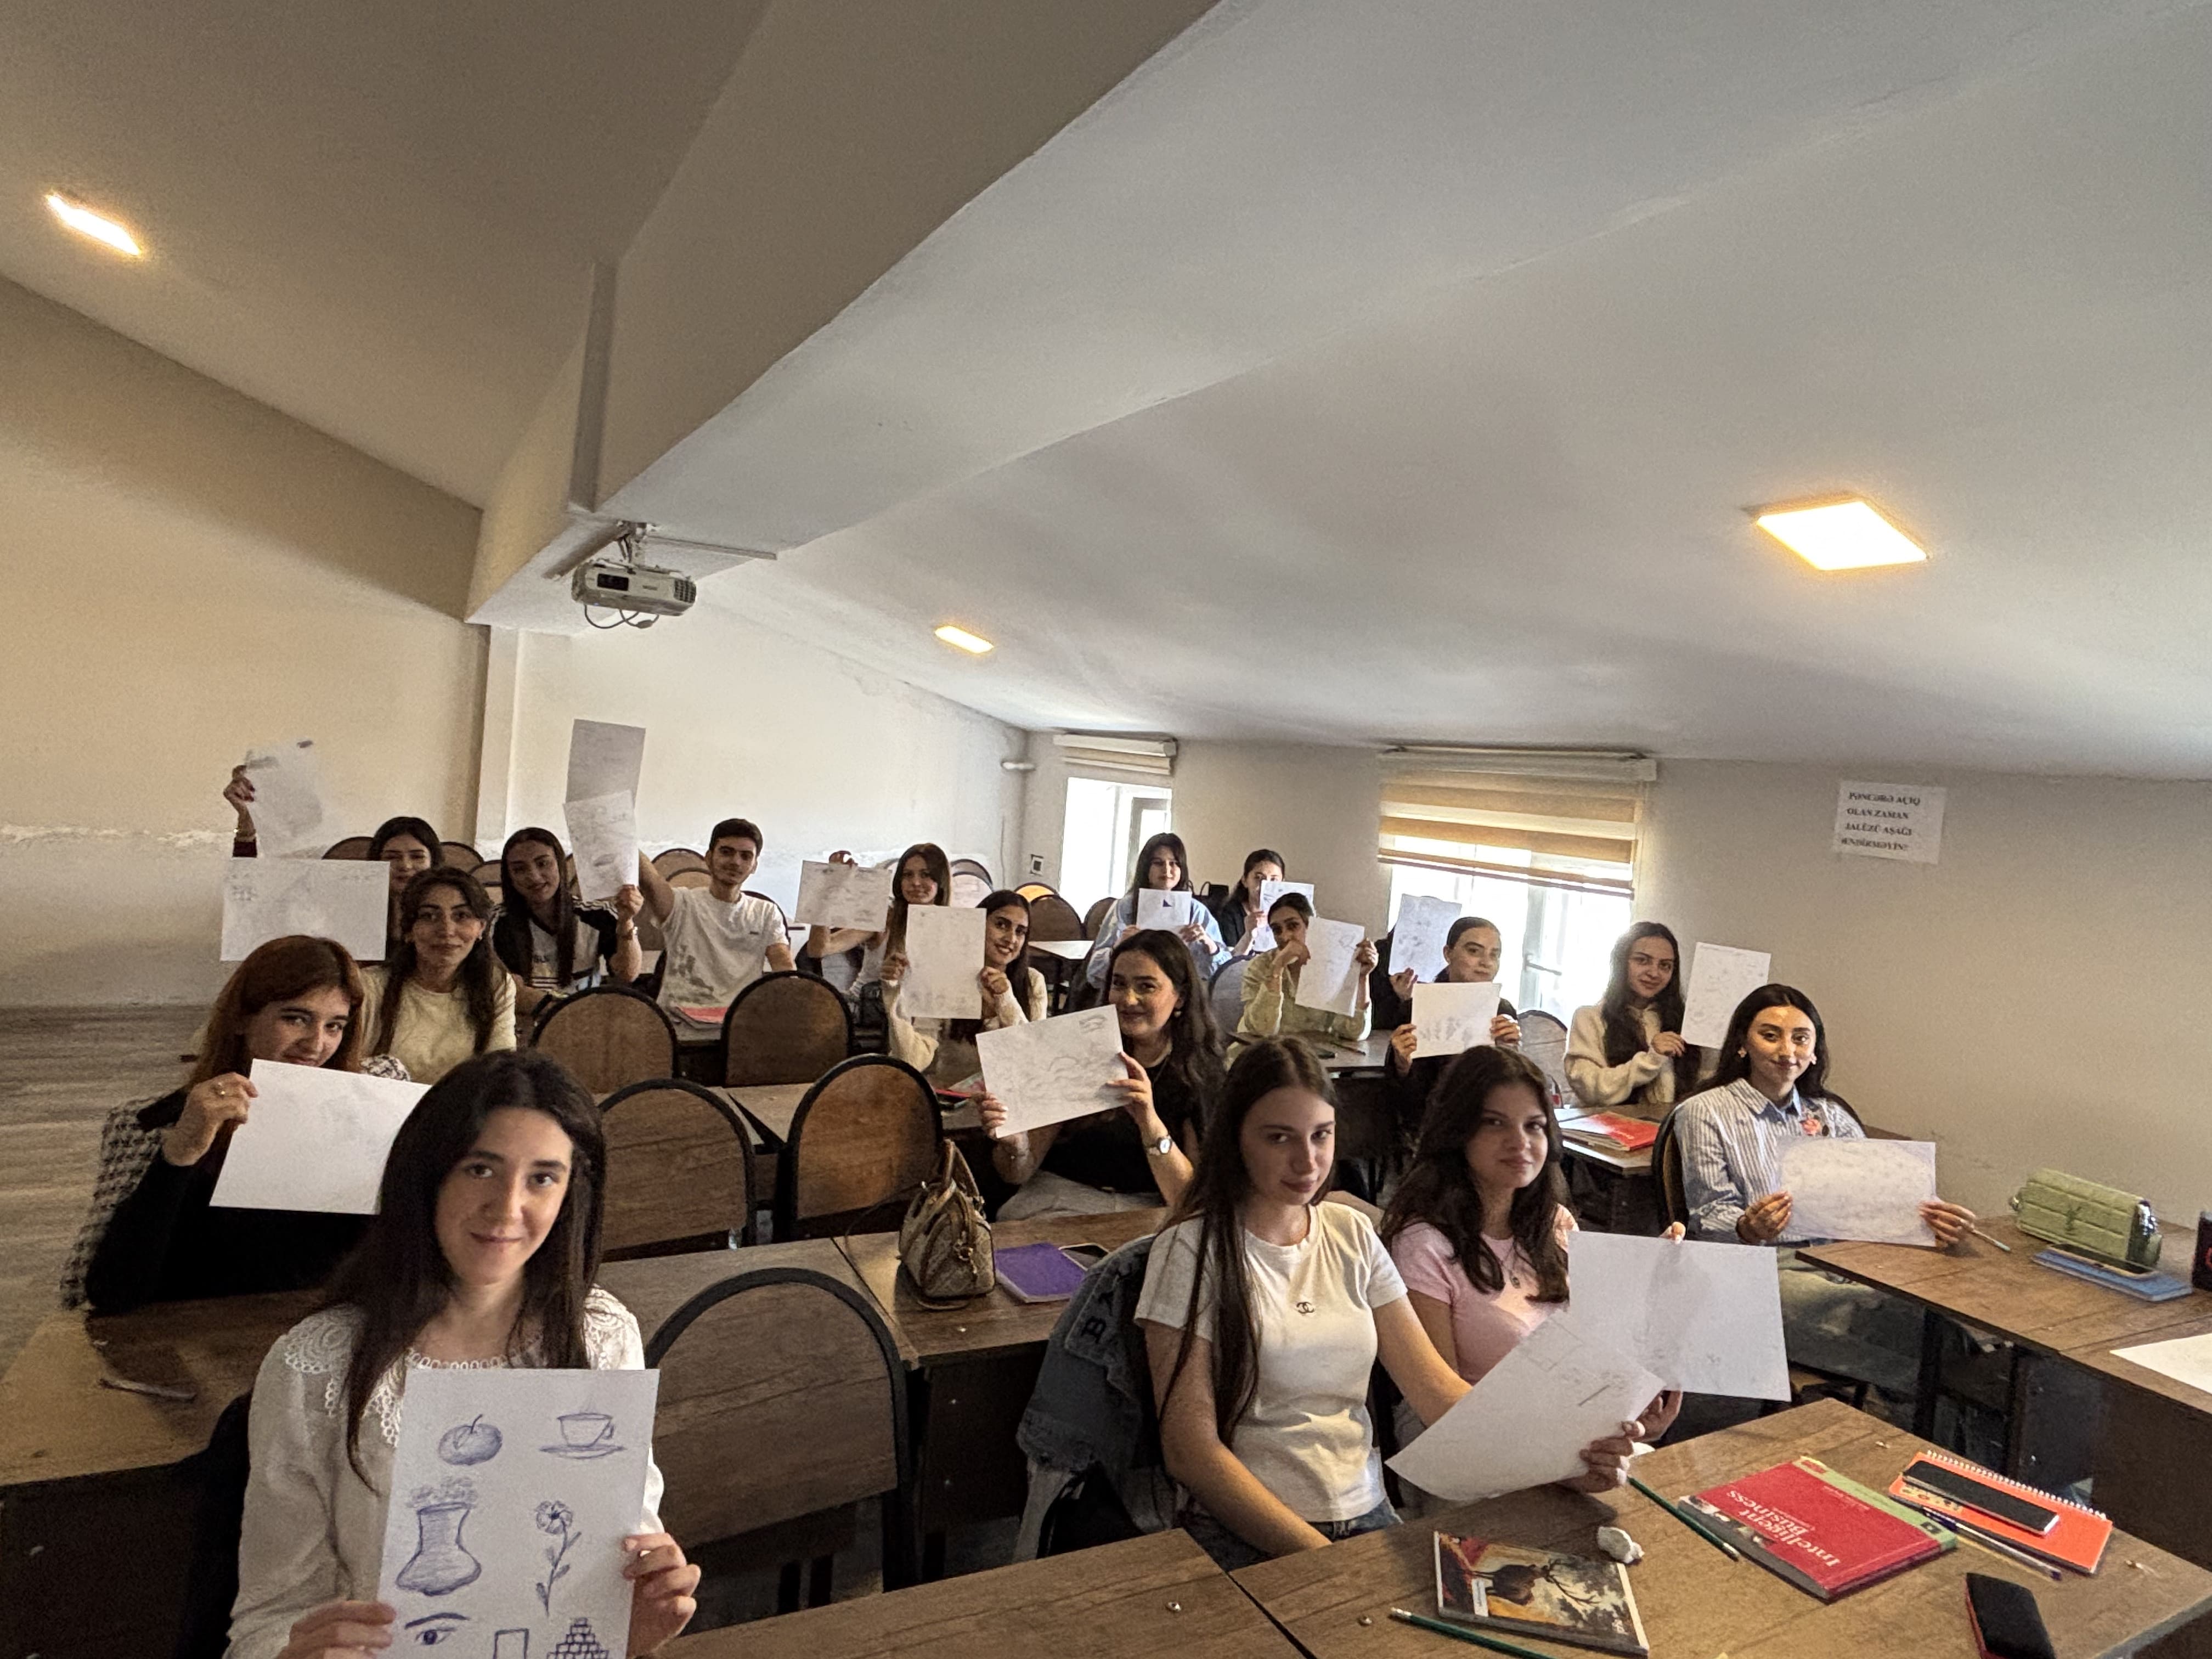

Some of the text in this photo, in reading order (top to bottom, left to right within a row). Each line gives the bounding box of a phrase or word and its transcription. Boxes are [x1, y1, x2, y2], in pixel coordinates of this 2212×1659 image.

[1874, 810, 1909, 819] ZAMAN
[1726, 1490, 1809, 1536] Business
[1739, 1510, 1840, 1567] Intelligent
